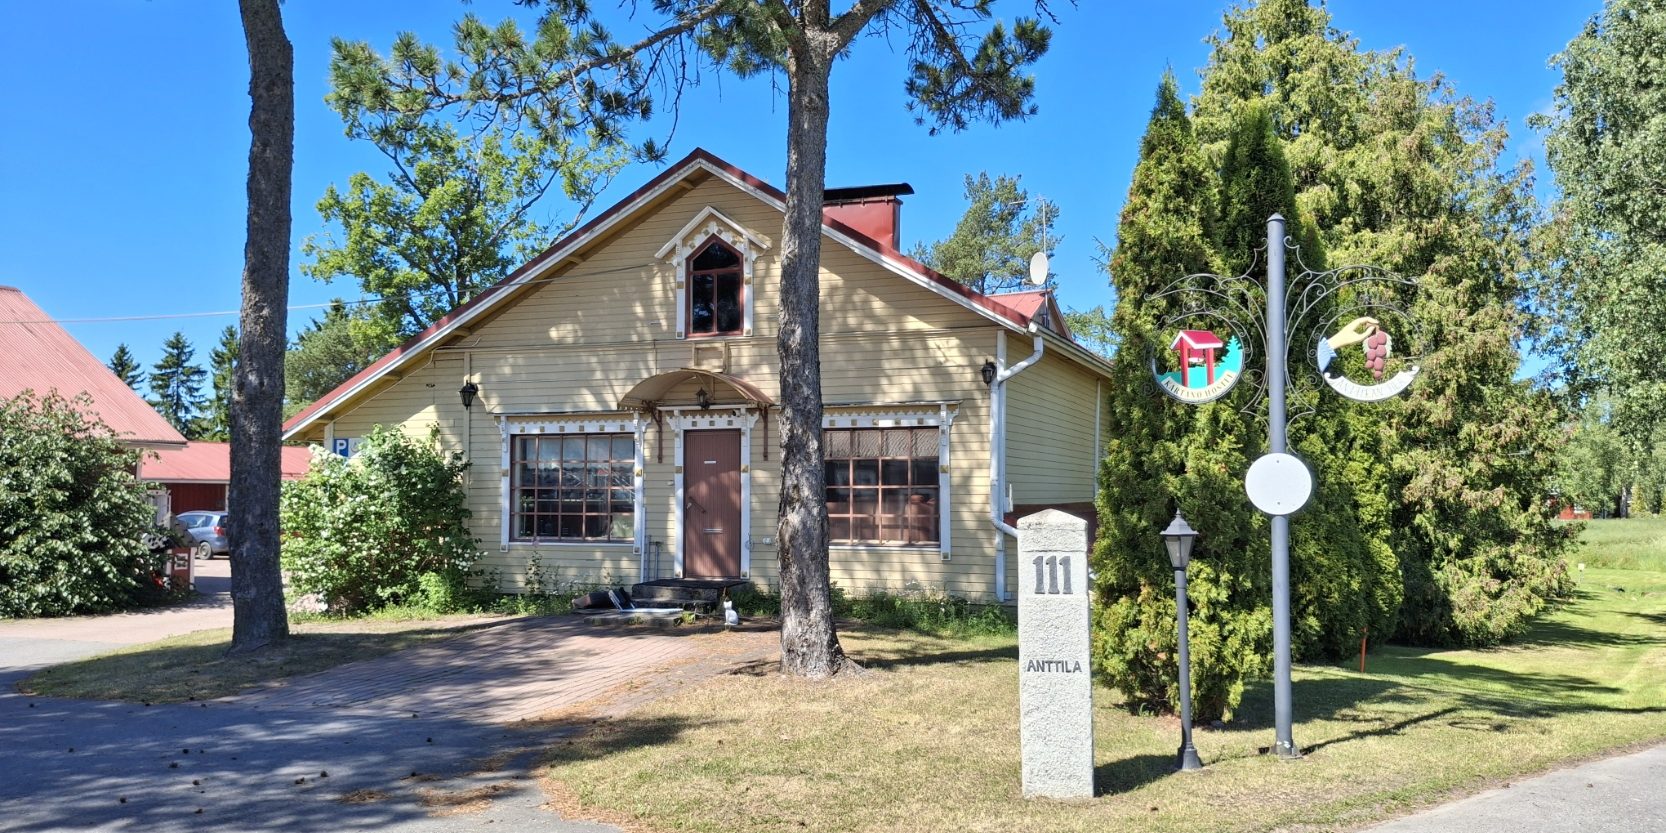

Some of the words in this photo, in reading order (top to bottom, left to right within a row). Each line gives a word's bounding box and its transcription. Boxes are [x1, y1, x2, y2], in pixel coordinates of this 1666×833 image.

[336, 439, 347, 455] P
[1033, 555, 1073, 594] 111
[1027, 660, 1082, 673] ANTTILA
